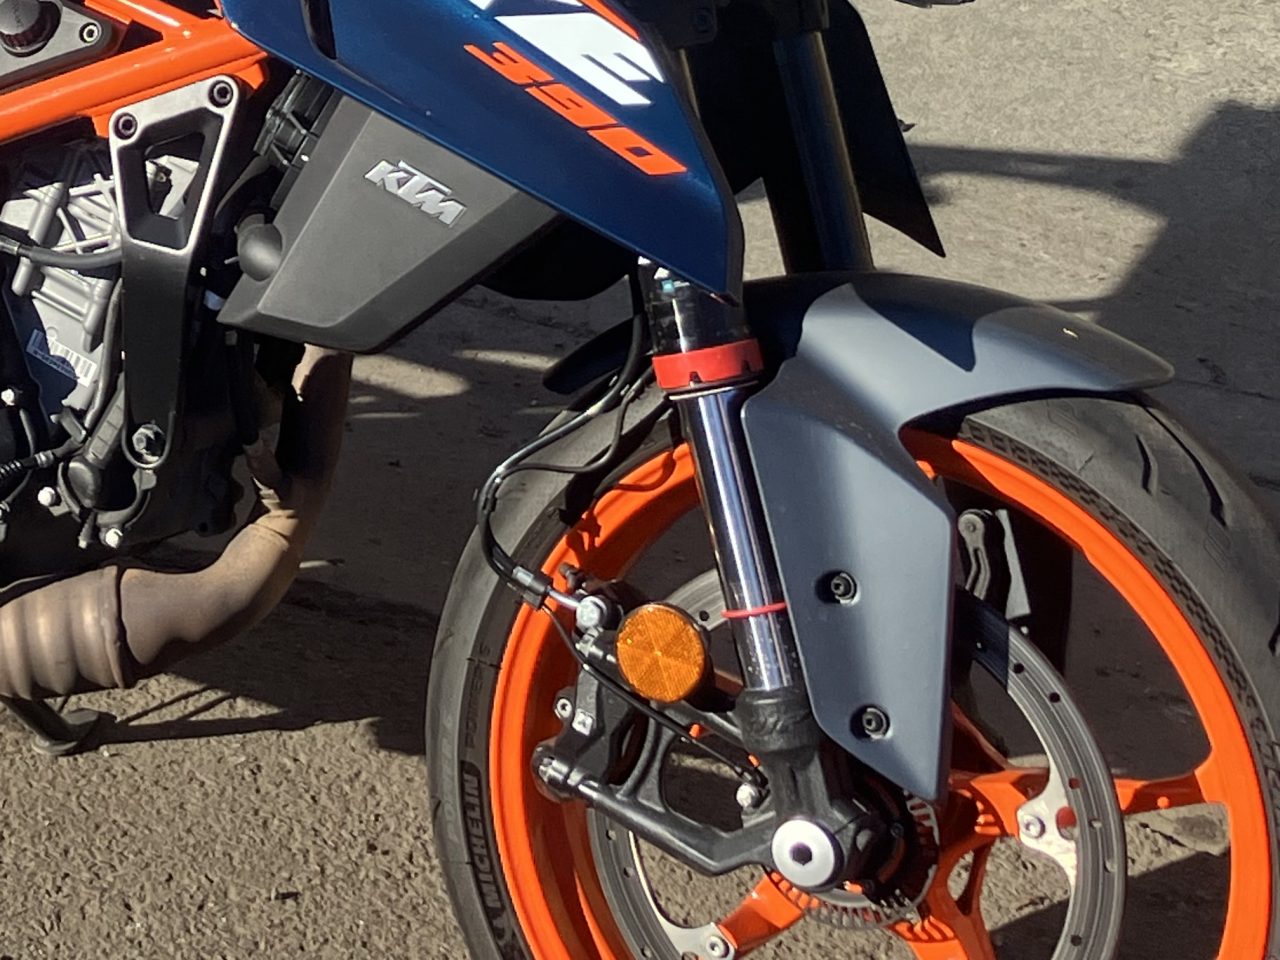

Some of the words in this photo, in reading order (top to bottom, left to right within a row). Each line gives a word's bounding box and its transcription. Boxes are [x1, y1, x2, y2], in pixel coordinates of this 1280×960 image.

[463, 41, 688, 176] 390
[363, 159, 468, 228] KTM
[464, 772, 503, 908] MICHELIN
